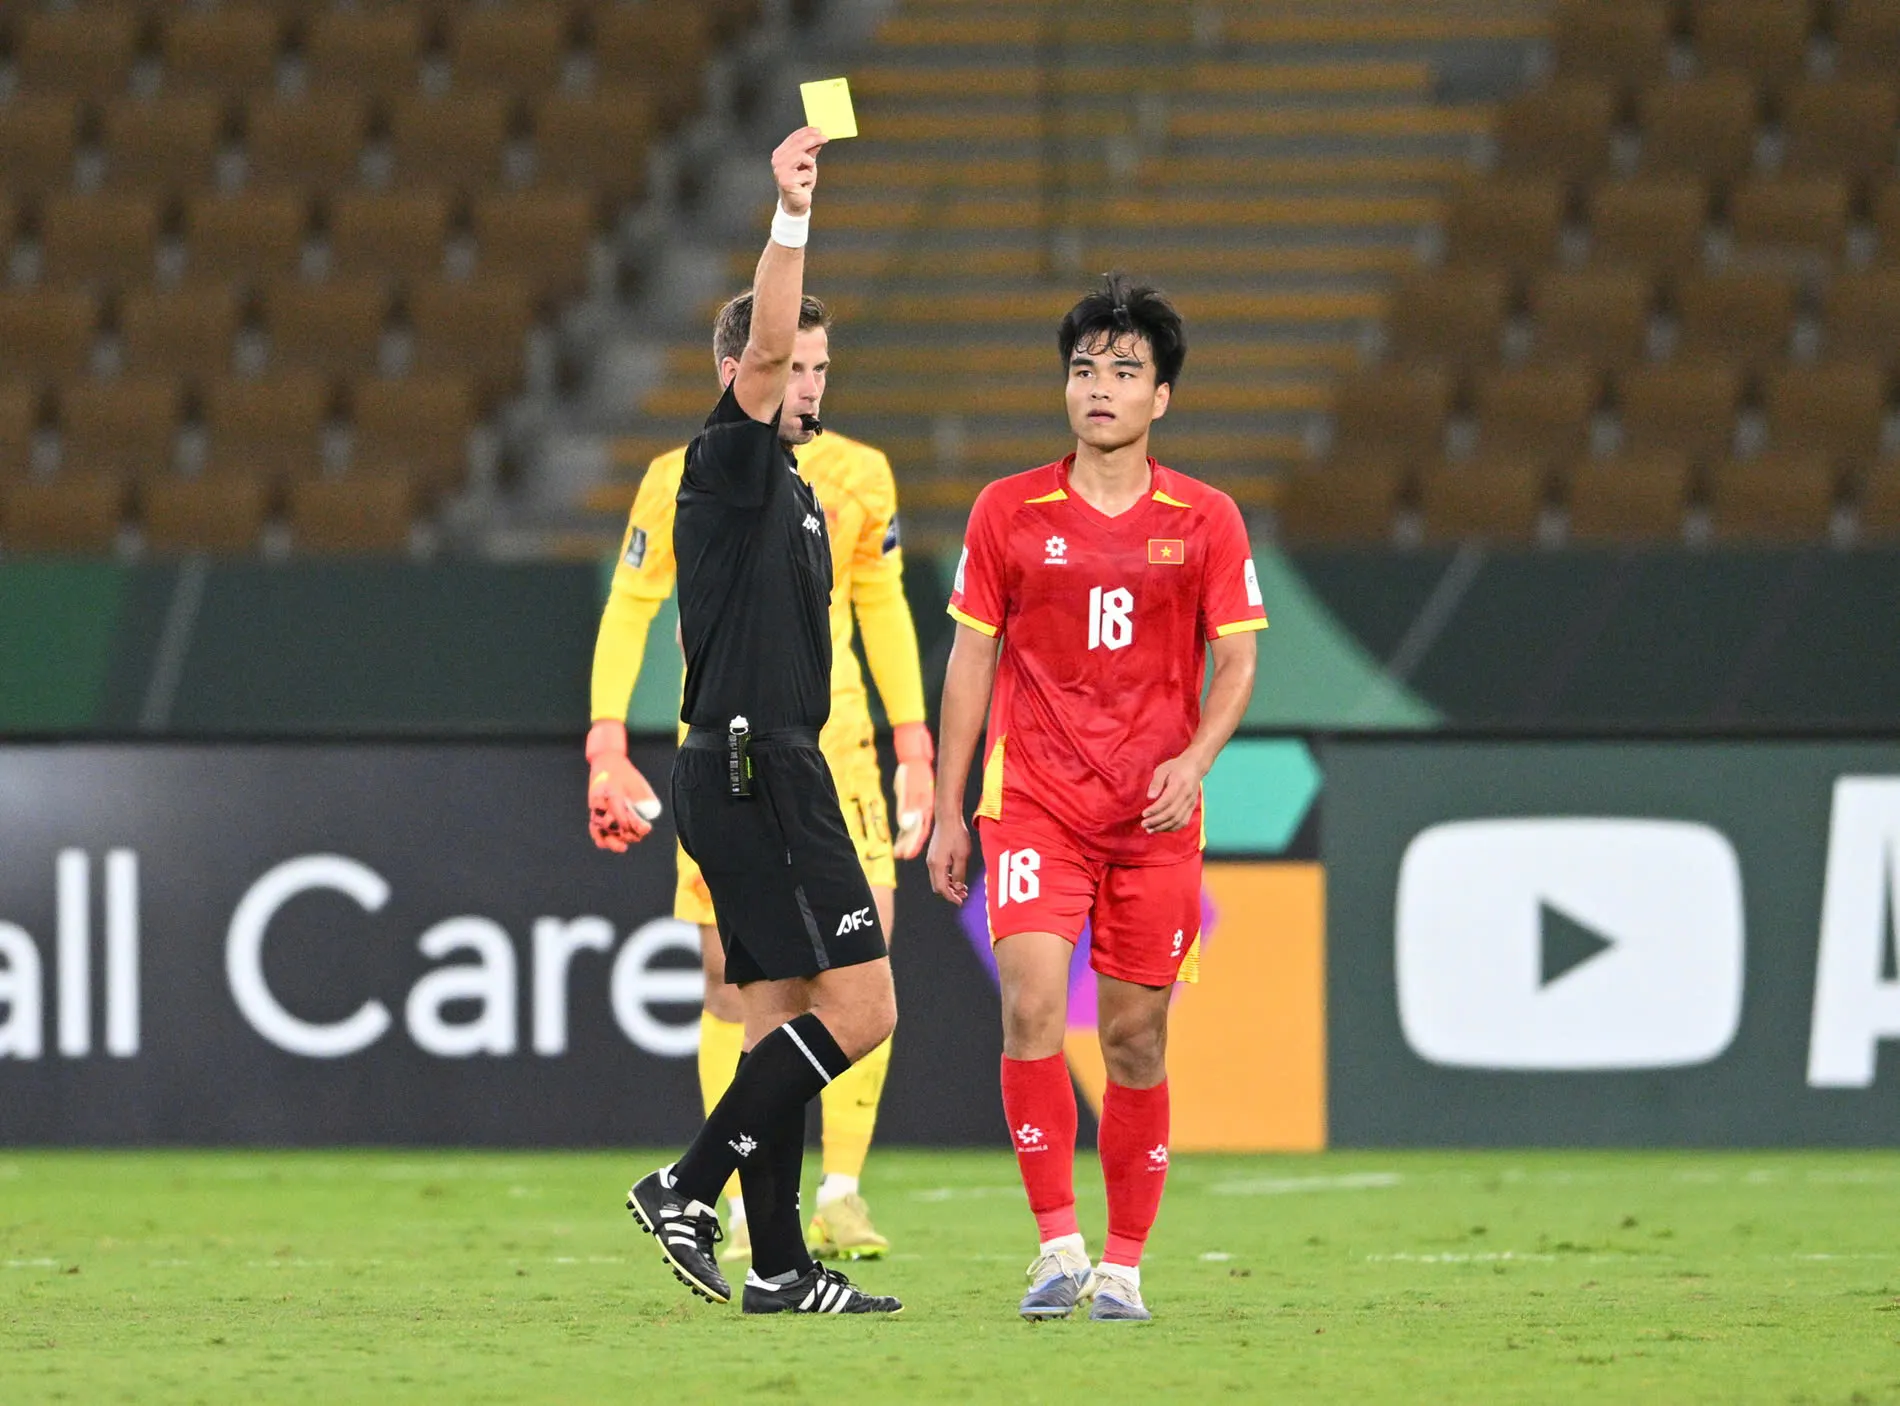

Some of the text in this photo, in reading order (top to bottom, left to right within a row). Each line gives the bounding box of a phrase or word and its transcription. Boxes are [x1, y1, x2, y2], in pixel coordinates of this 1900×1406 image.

[1088, 586, 1135, 651] 18
[998, 848, 1041, 909] 18
[835, 906, 874, 937] AFC
[226, 852, 704, 1057] Care
